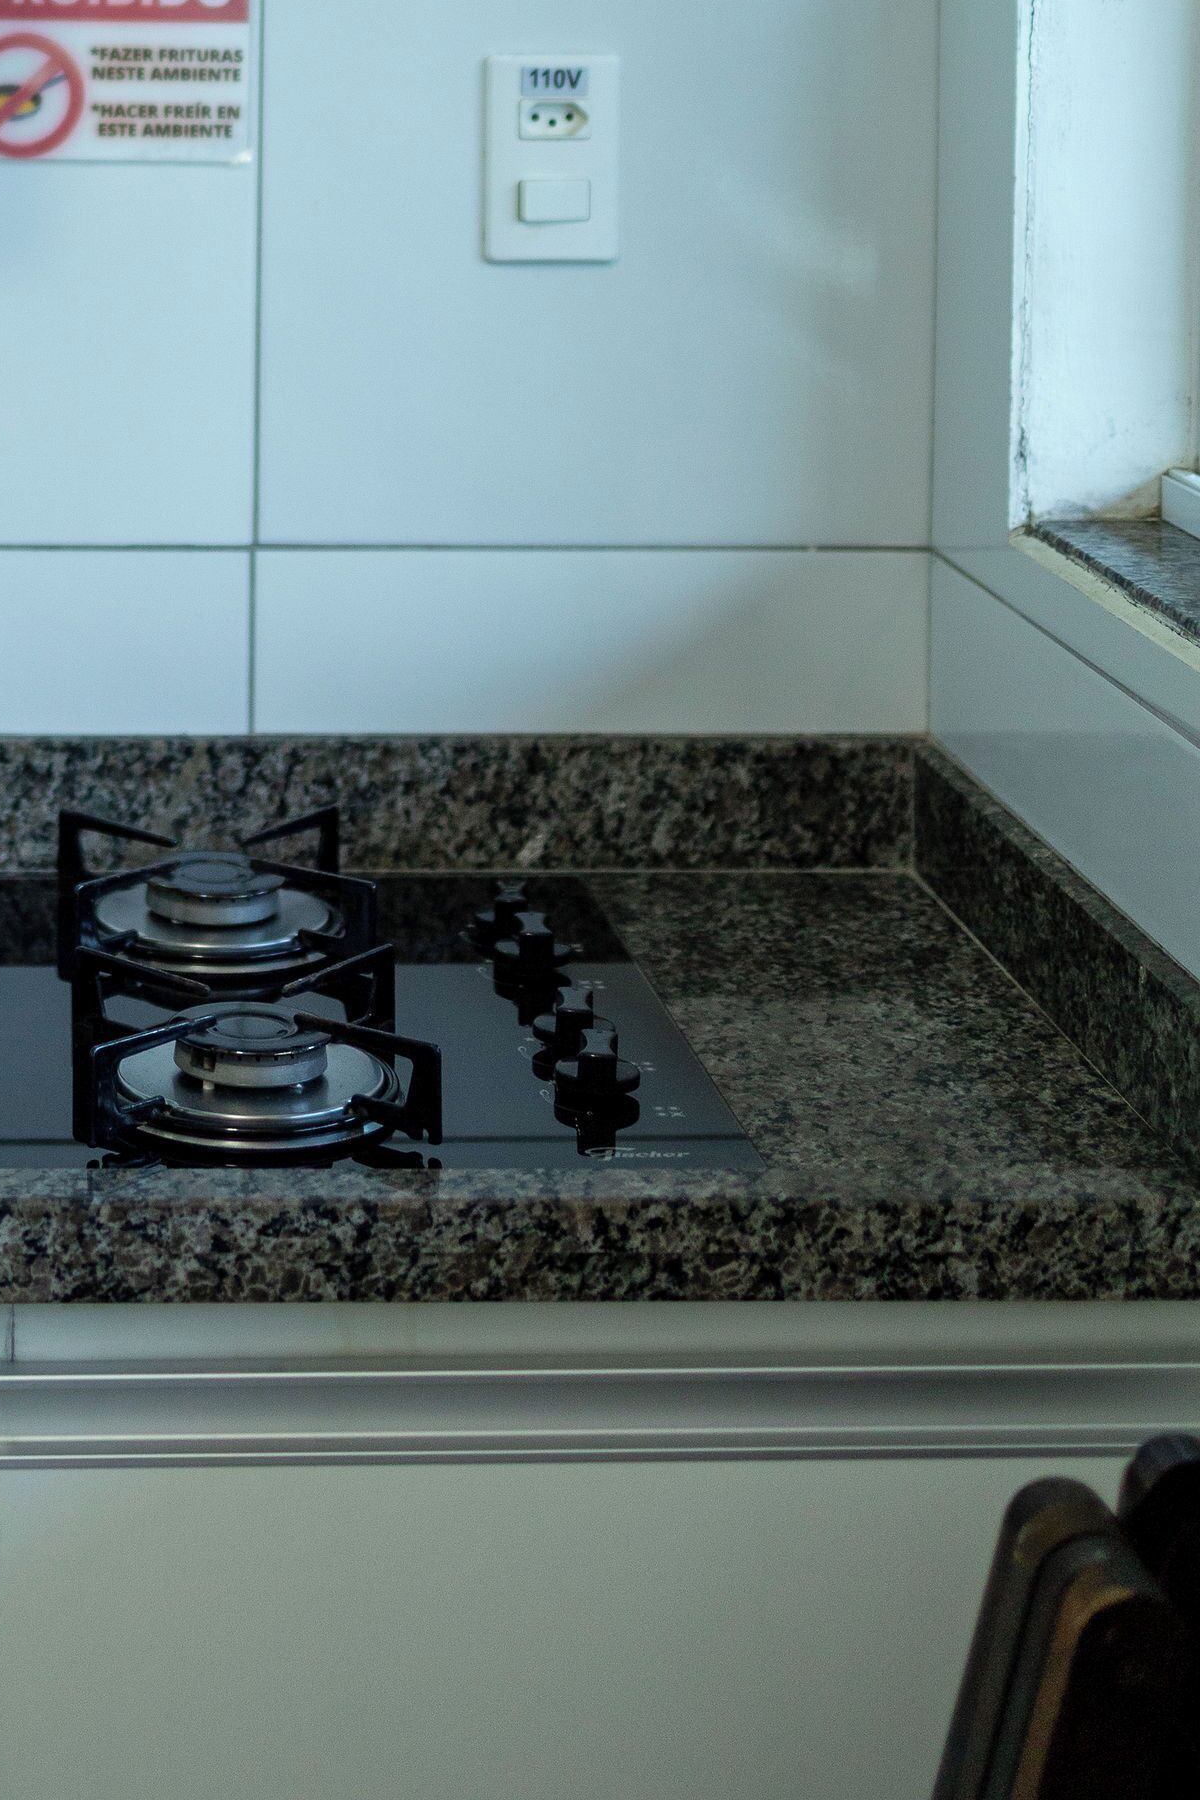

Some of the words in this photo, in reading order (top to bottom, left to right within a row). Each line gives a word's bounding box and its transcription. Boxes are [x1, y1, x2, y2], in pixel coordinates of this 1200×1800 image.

[158, 48, 243, 64] FRITURAS
[92, 66, 146, 81] NESTE
[151, 67, 241, 82] AMBIENTE
[529, 68, 583, 89] 110V
[217, 105, 240, 120] EN
[96, 123, 137, 137] ESTE
[141, 123, 233, 138] AMBIENTE
